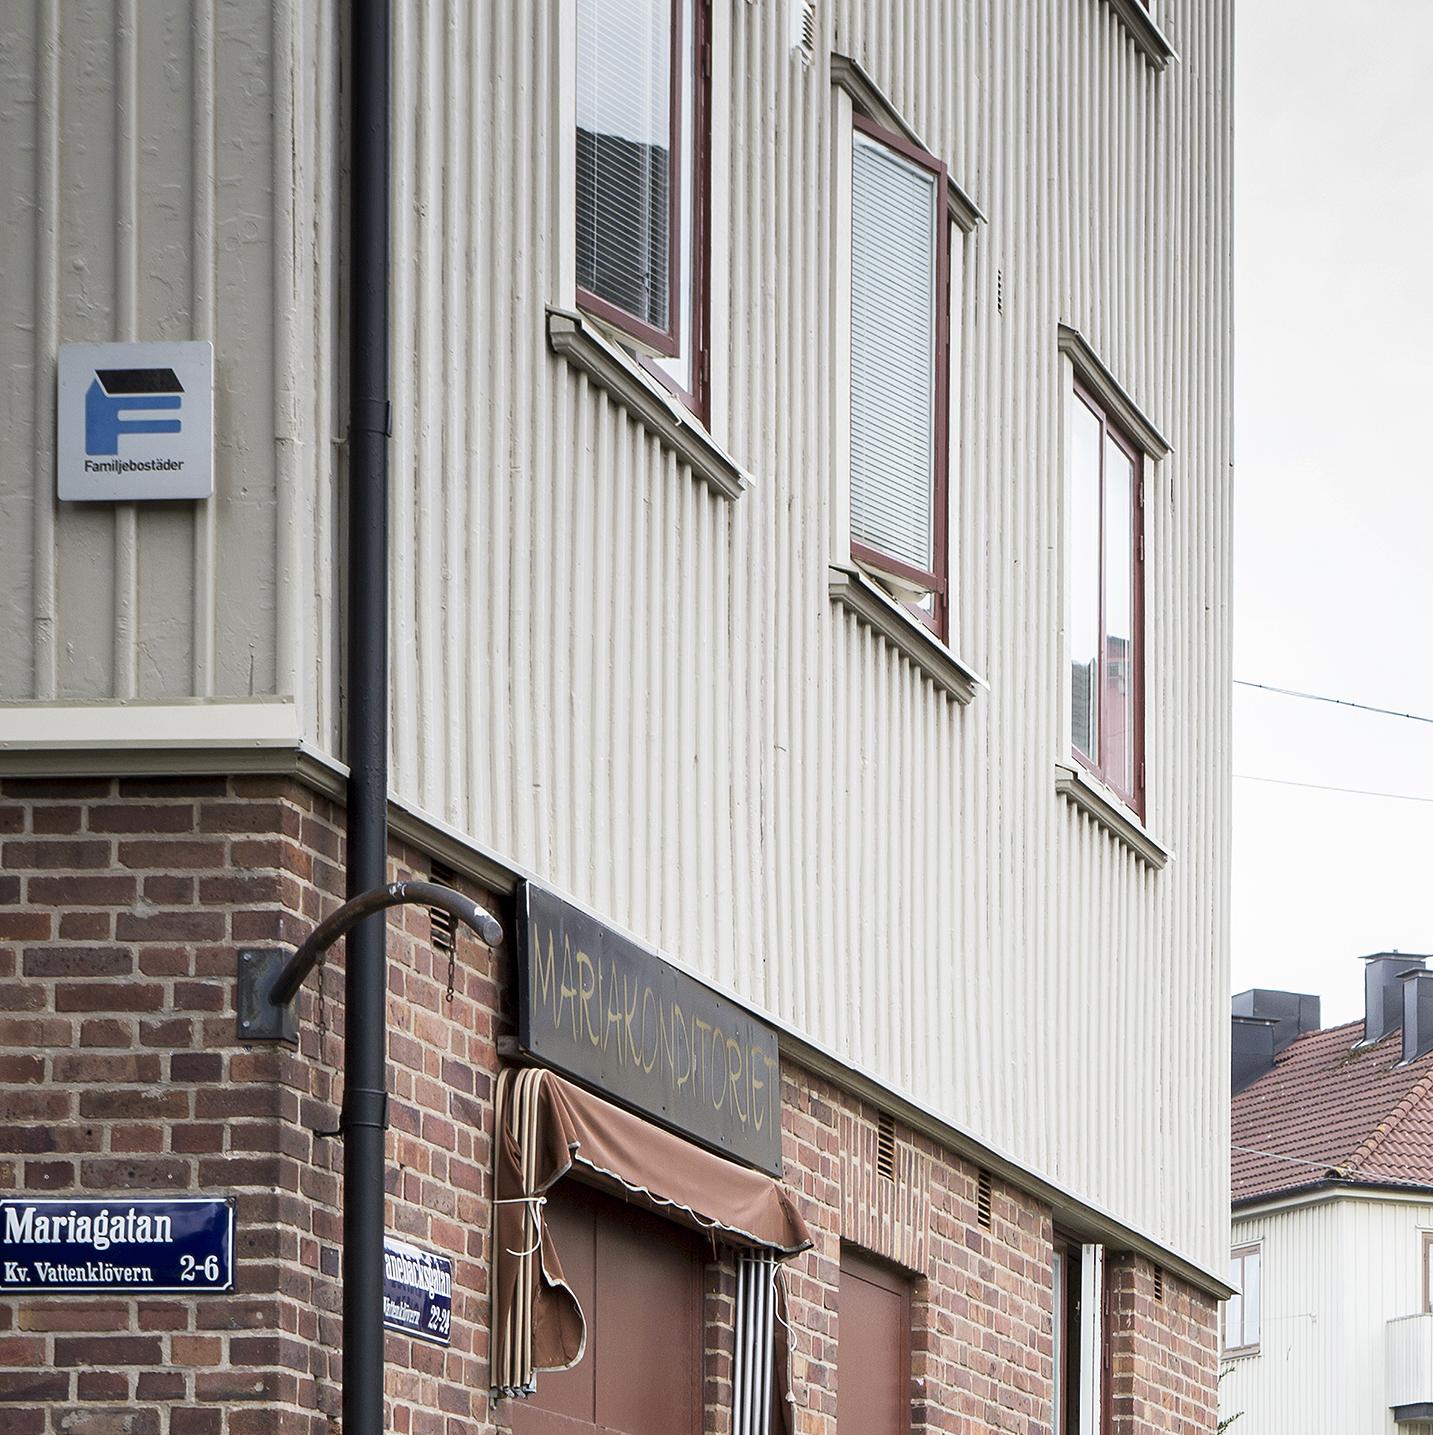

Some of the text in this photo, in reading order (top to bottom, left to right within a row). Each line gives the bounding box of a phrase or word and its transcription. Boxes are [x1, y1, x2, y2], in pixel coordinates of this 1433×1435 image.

[84, 459, 184, 474] Familjebostäder
[4, 1207, 173, 1250] Mariagatan
[4, 1255, 219, 1282] Kv. Vattenklövern 2-6
[428, 1305, 450, 1334] 22-24
